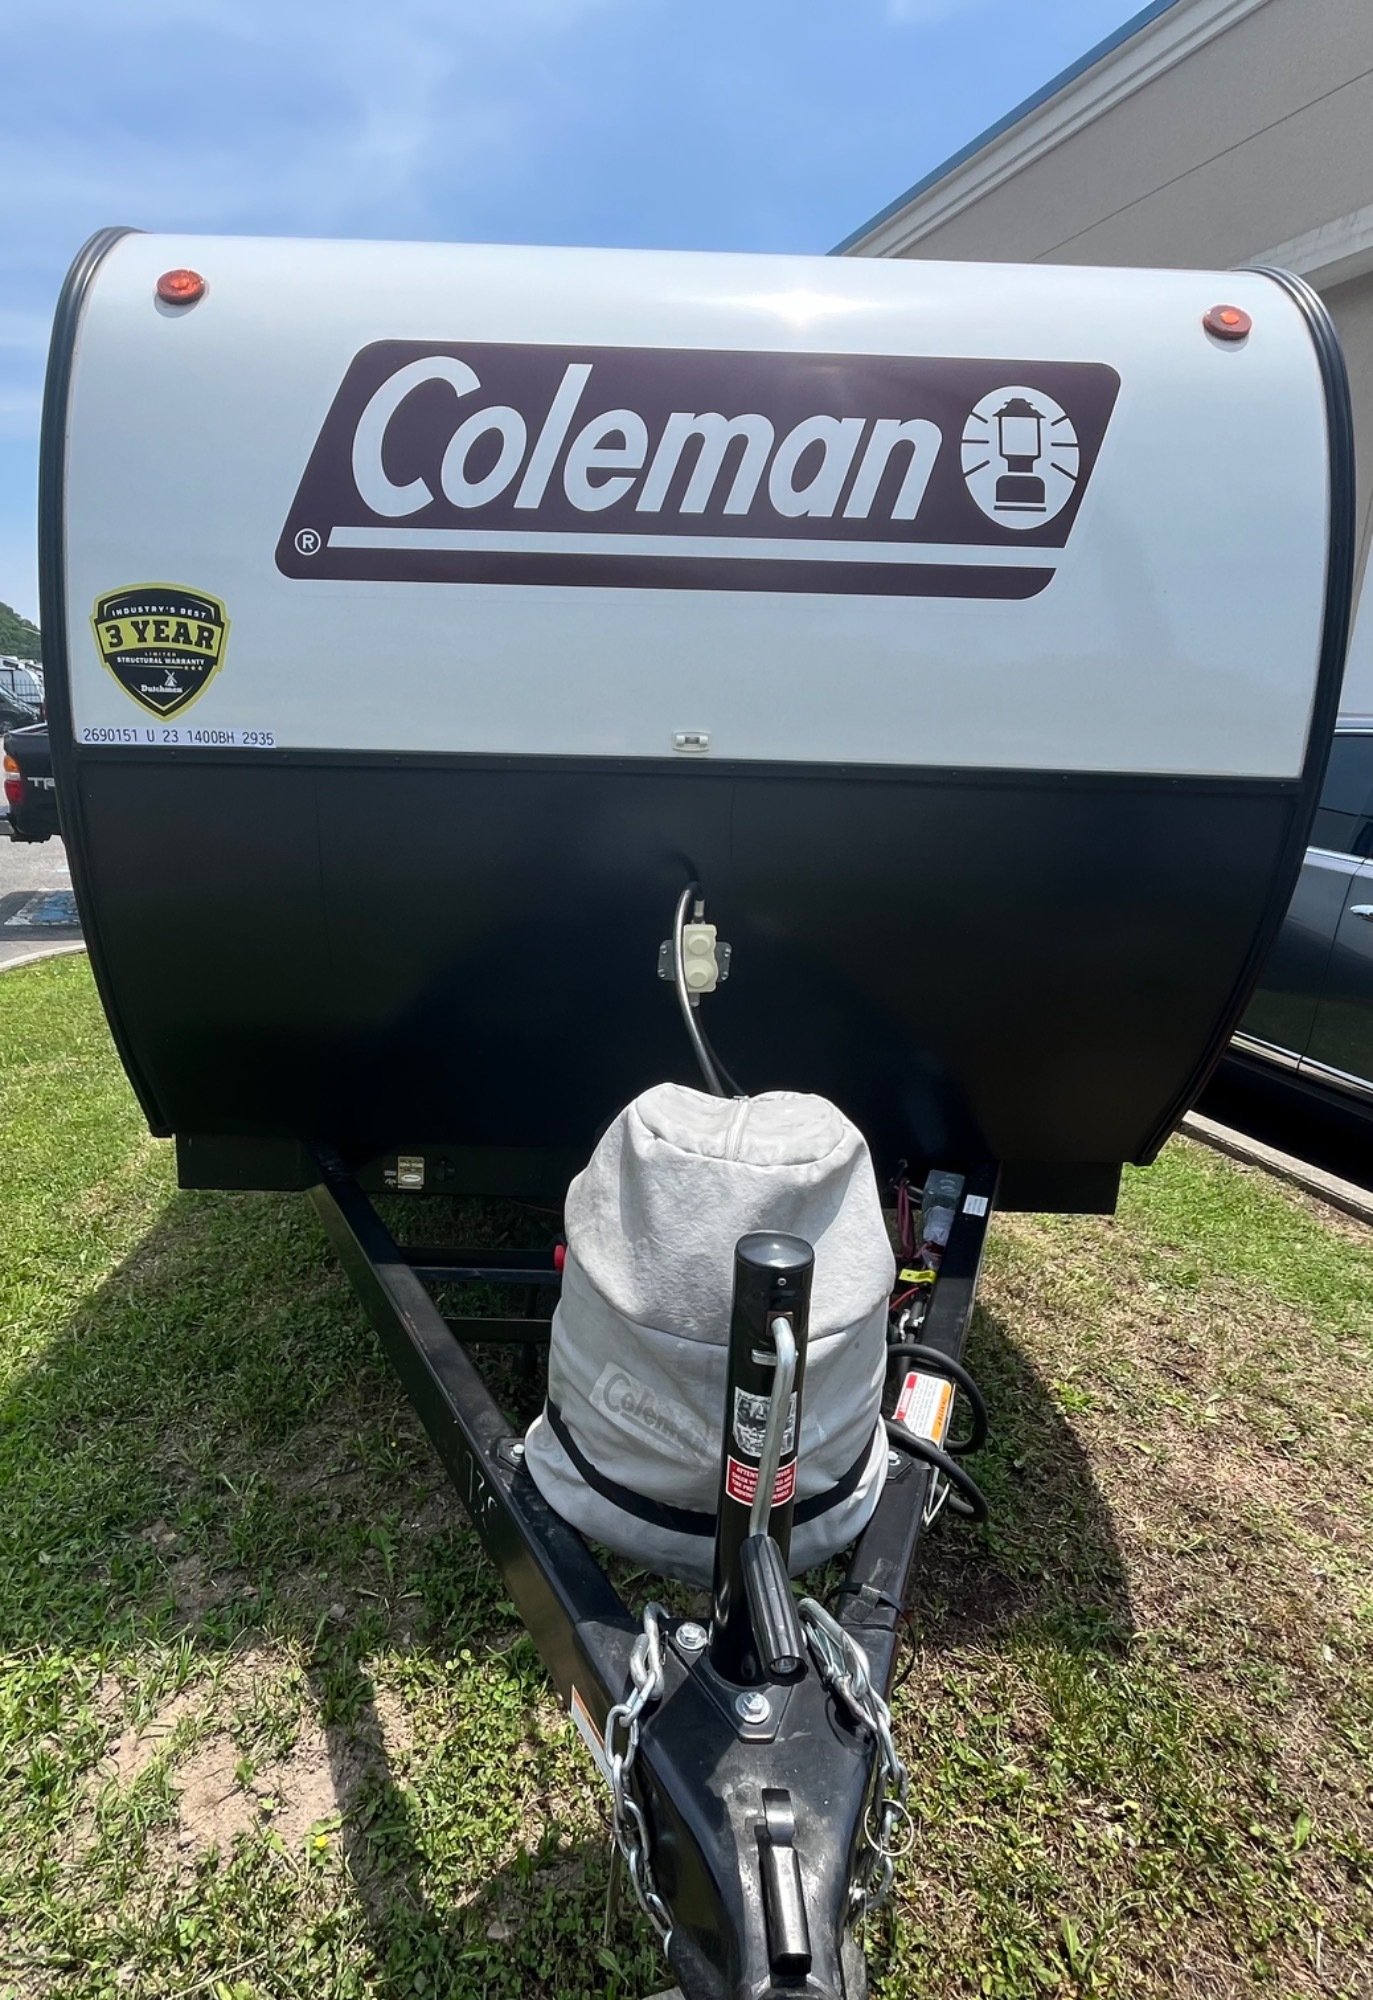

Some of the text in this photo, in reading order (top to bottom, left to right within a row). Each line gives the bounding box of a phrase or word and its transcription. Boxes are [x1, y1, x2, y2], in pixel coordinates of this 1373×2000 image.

[352, 356, 943, 521] Coleman
[111, 605, 206, 619] INDUSTRY'S BEST
[105, 620, 215, 650] 3 YEAR
[117, 656, 205, 666] STRUCTURAL WARRANTY
[140, 684, 183, 693] Dutchmen
[83, 727, 275, 746] 2690151 U 23 1400BH 2935
[27, 776, 56, 791] TR
